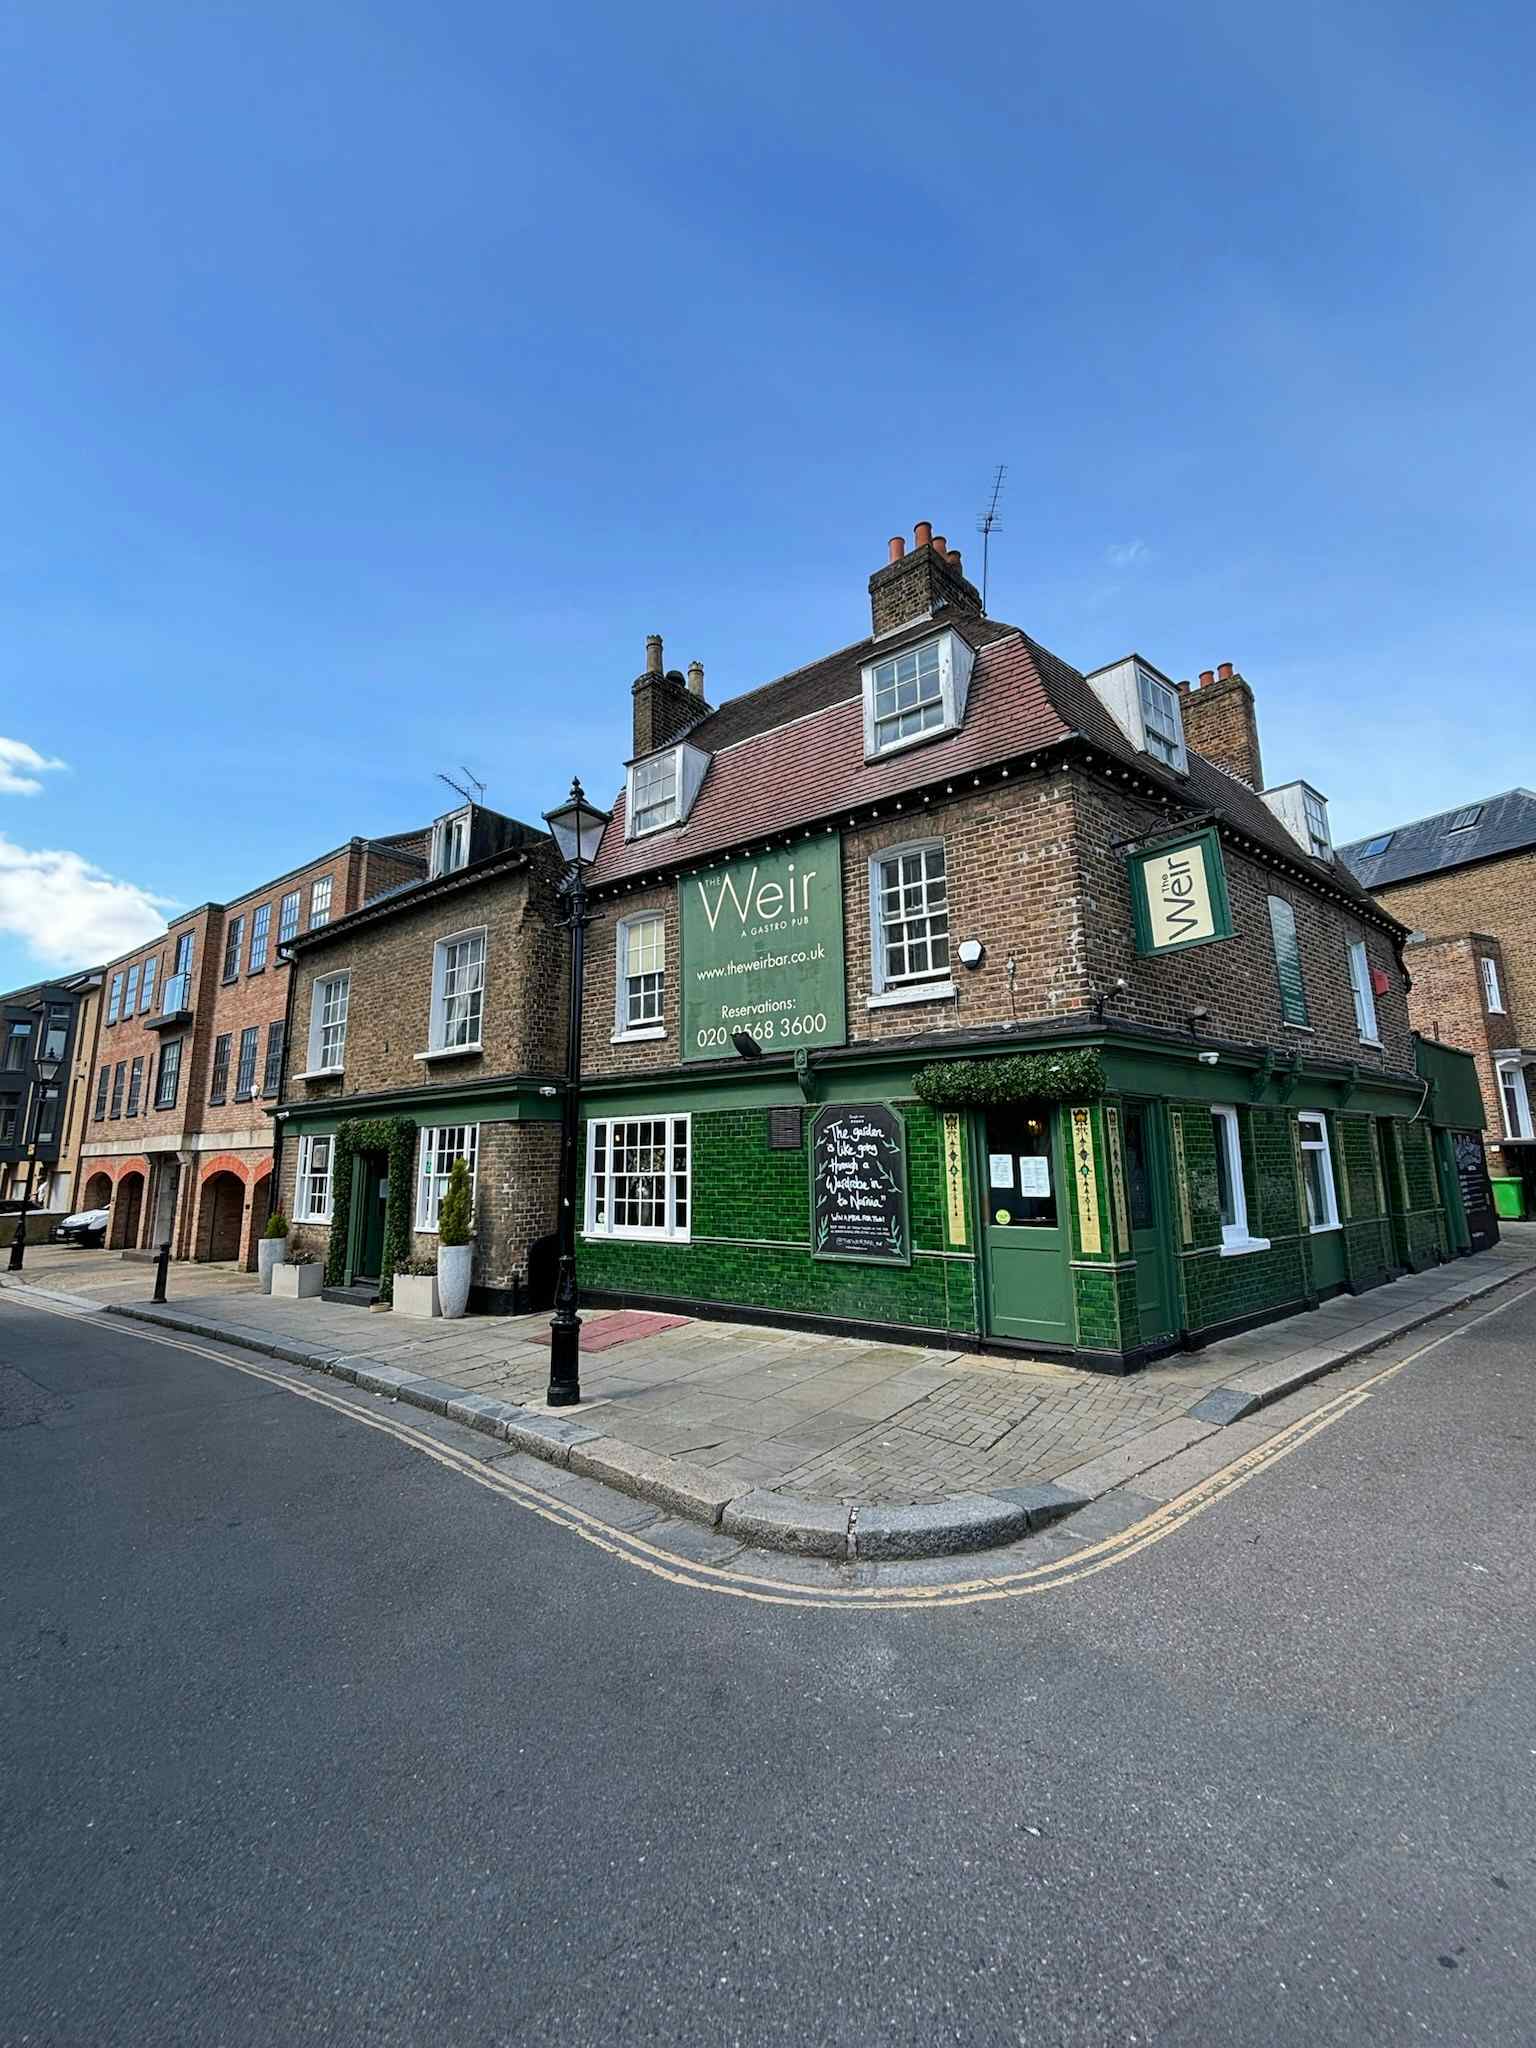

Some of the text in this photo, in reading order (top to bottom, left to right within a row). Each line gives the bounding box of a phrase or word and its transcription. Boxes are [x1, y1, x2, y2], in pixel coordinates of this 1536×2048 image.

[704, 877, 721, 888] THE
[1161, 873, 1170, 892] The
[698, 864, 817, 932] Weir
[1163, 857, 1198, 941] Weir
[741, 916, 809, 938] A GASTRO PUB
[696, 943, 825, 981] www.theweirbar.co.uk
[721, 999, 797, 1019] Reservations:
[697, 1026, 727, 1047] 020
[780, 1013, 827, 1037] 3600
[850, 1123, 885, 1142] garden
[836, 1140, 857, 1157] like
[856, 1142, 878, 1158] going
[827, 1155, 870, 1175] through a
[869, 1177, 883, 1189] in
[836, 1191, 848, 1207] to
